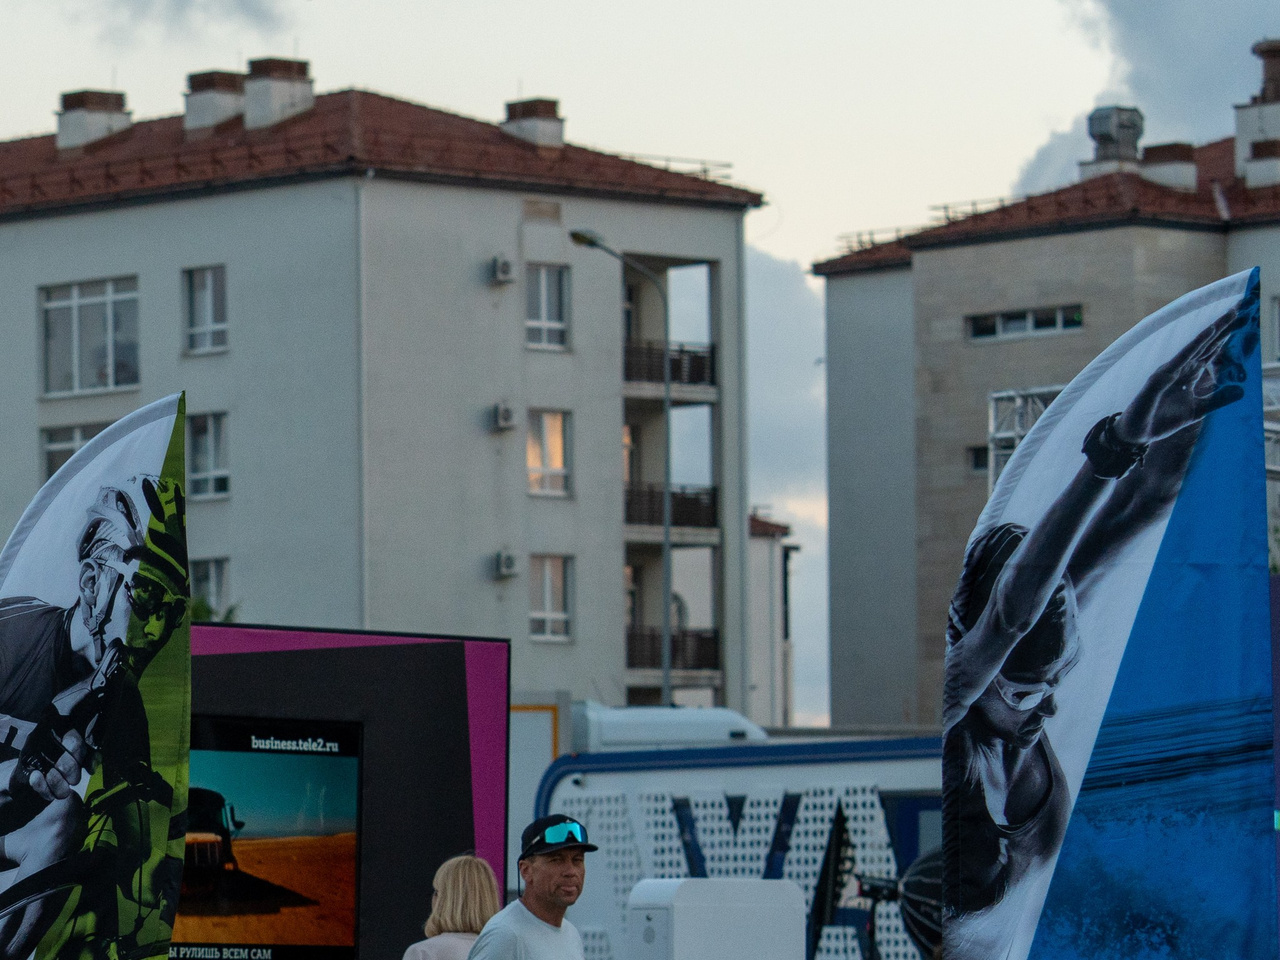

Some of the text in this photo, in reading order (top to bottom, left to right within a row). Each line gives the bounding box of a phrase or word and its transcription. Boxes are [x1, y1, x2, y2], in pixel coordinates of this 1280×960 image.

[251, 735, 339, 752] business.tele2.ru
[180, 947, 220, 958] РУЛИШЬ
[222, 948, 248, 959] ВСЕМ
[250, 949, 272, 960] САМ
